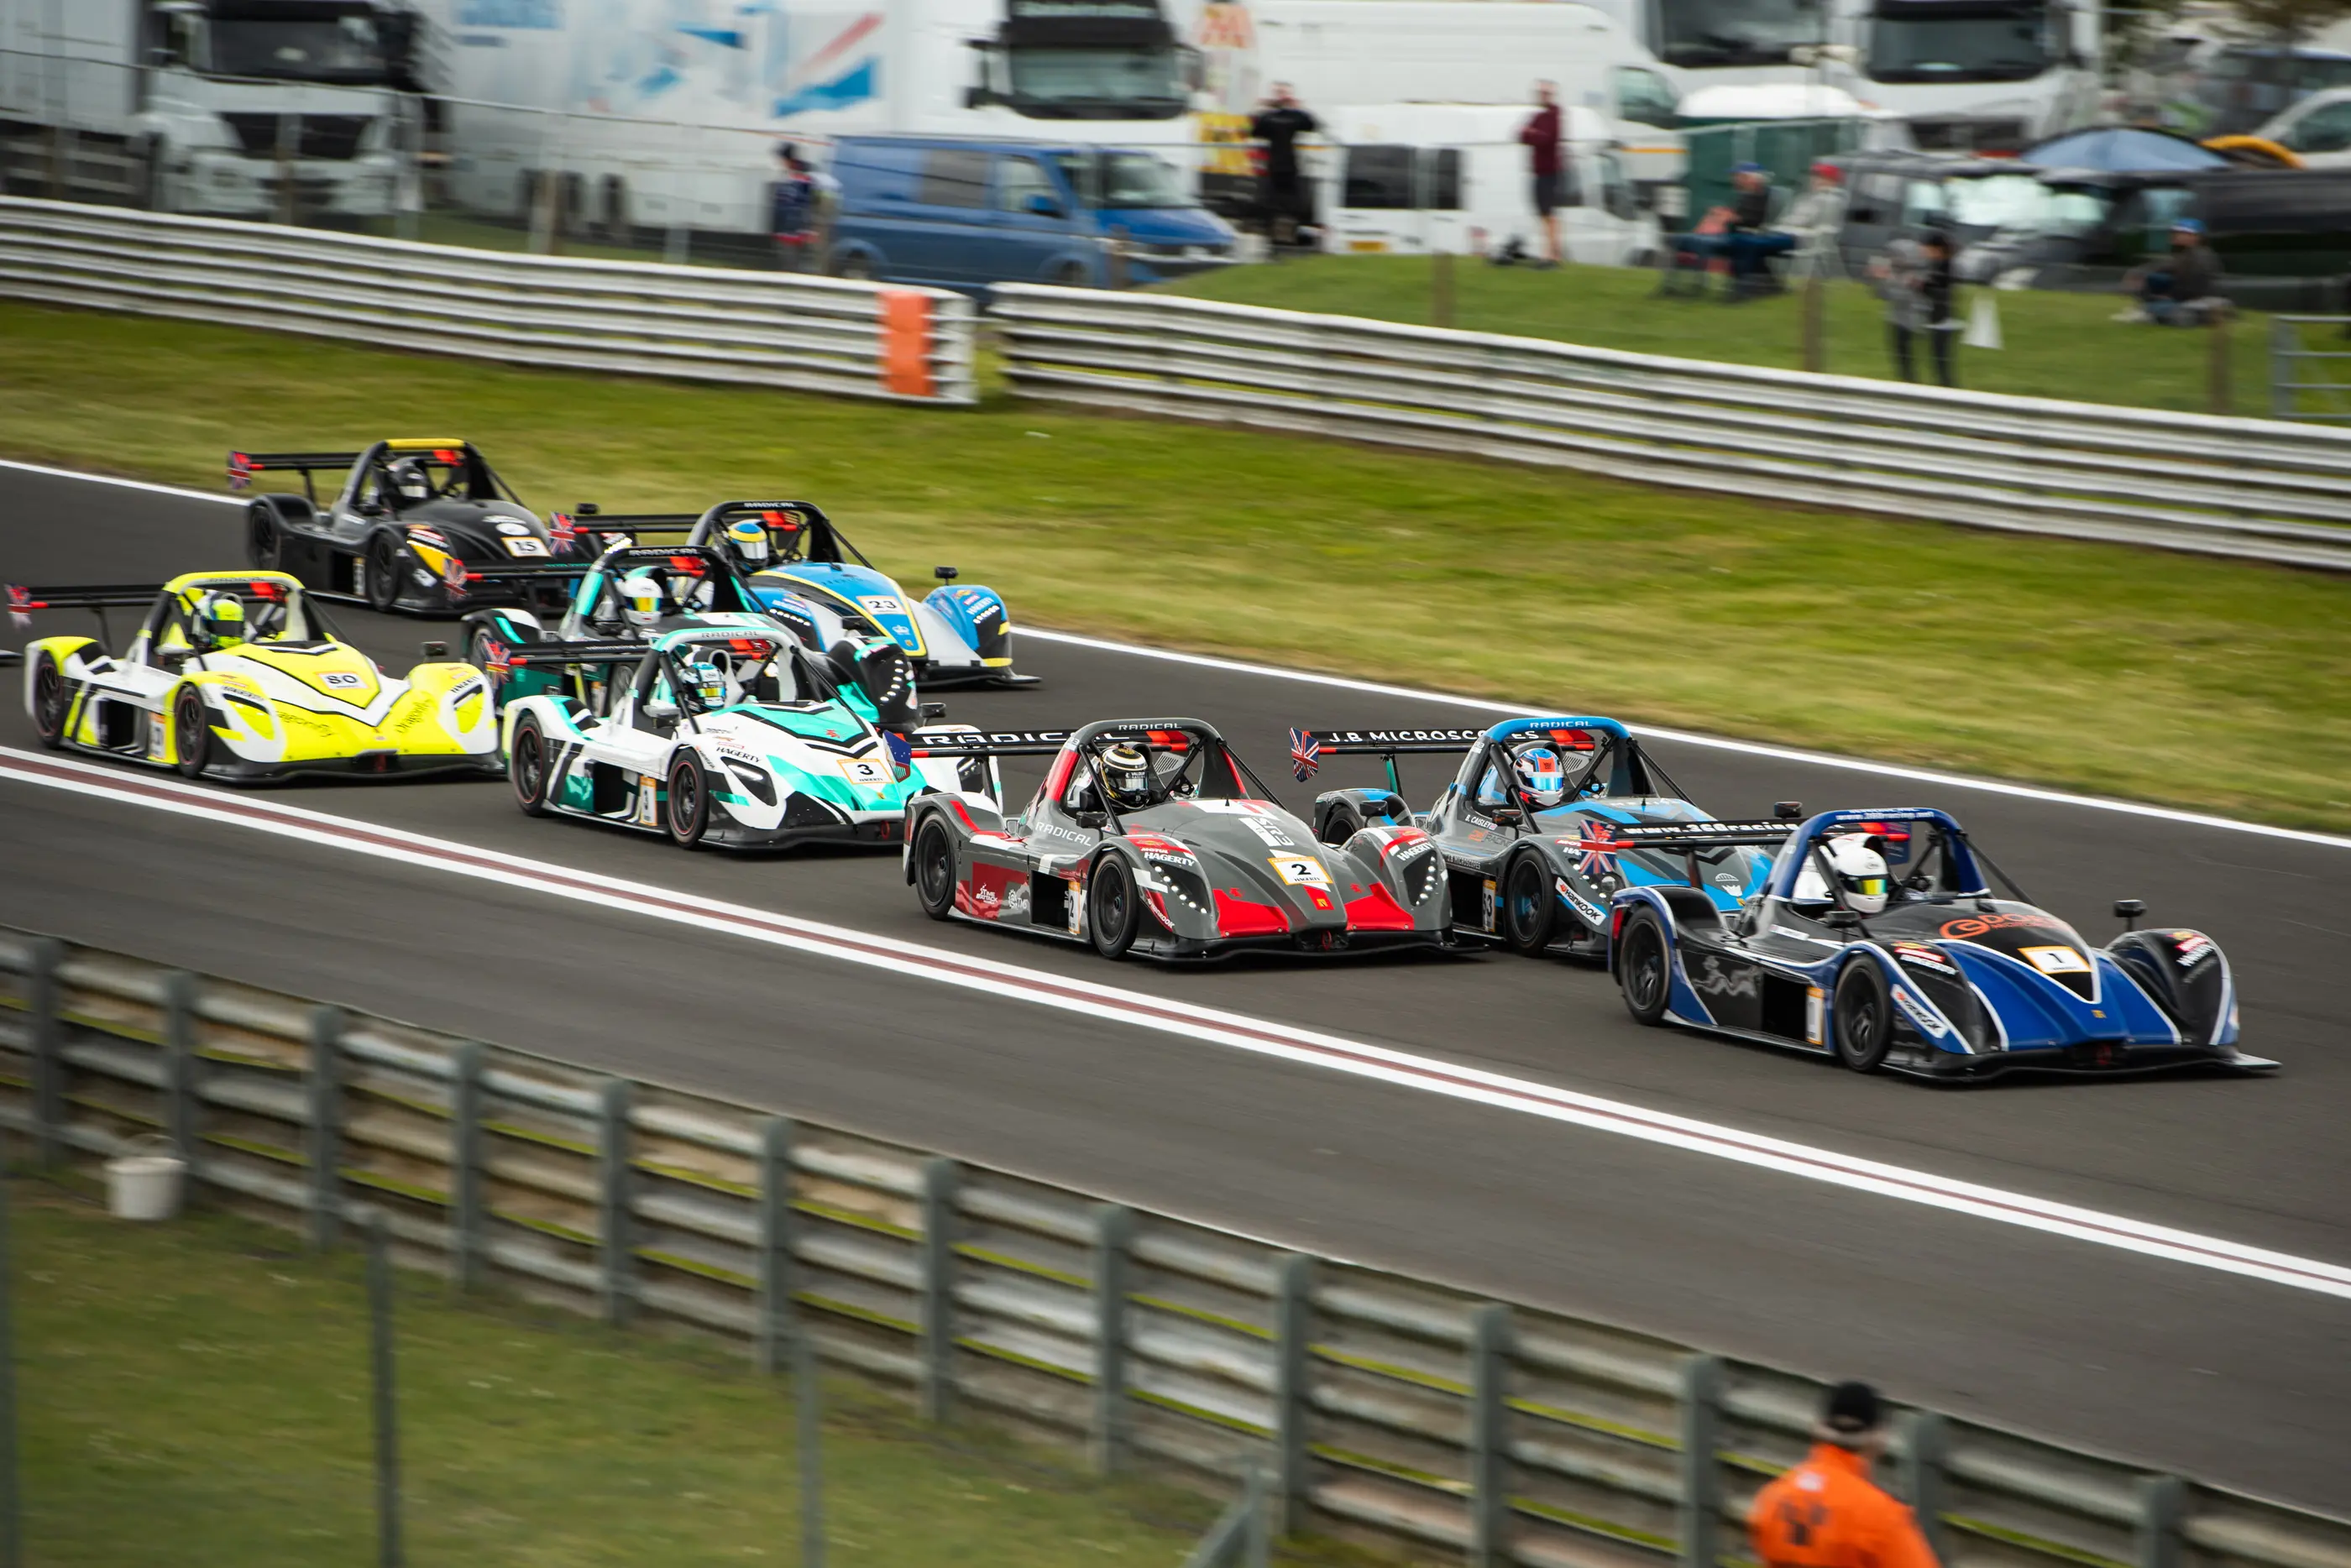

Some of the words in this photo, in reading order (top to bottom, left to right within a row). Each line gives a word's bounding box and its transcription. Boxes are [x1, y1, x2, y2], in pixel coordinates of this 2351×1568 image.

[868, 600, 897, 609] 23
[923, 731, 1129, 745] RADICL
[1329, 731, 1362, 743] J.B
[1369, 729, 1539, 742] MICROSCES
[716, 747, 761, 763] HAGERTY
[857, 764, 874, 775] 3
[1471, 816, 1490, 828] CAISLEY
[1035, 822, 1092, 846] RADICAL
[1252, 817, 1296, 845] SR3
[1396, 842, 1434, 861] HAGERTY
[1144, 852, 1195, 866] HAGERTY
[1291, 864, 1312, 875] 2
[1069, 897, 1074, 917] 2
[2048, 953, 2063, 964] 1
